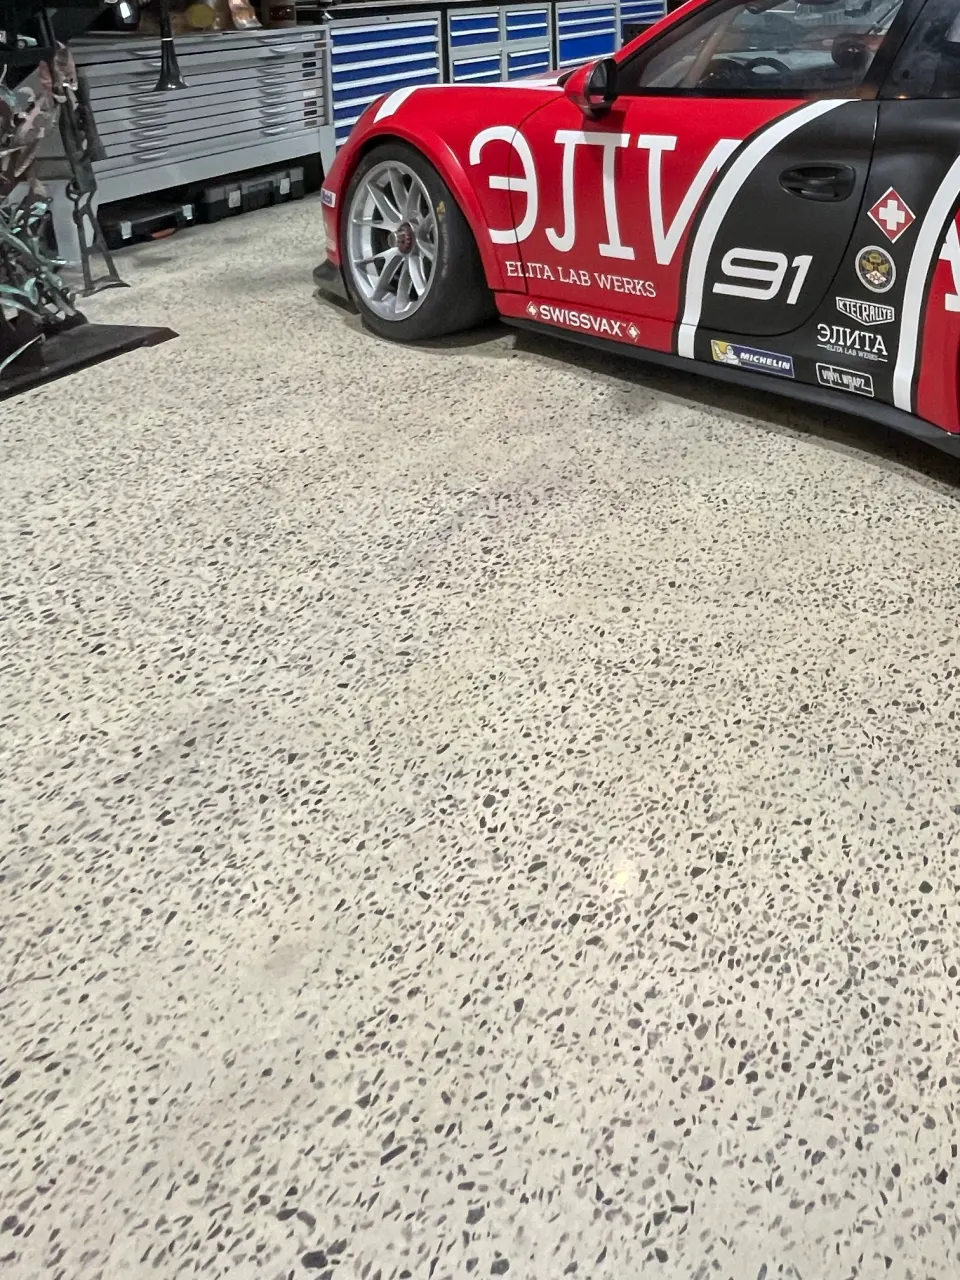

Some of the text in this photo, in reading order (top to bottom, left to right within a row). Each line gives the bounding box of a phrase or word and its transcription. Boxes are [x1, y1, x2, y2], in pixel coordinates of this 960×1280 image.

[506, 262, 657, 297] ELITA LAB WERKS
[713, 247, 813, 305] 91
[838, 300, 892, 322] KTECRALLYE
[817, 323, 888, 356] ЭЛИТА
[740, 352, 791, 370] MICHELIN
